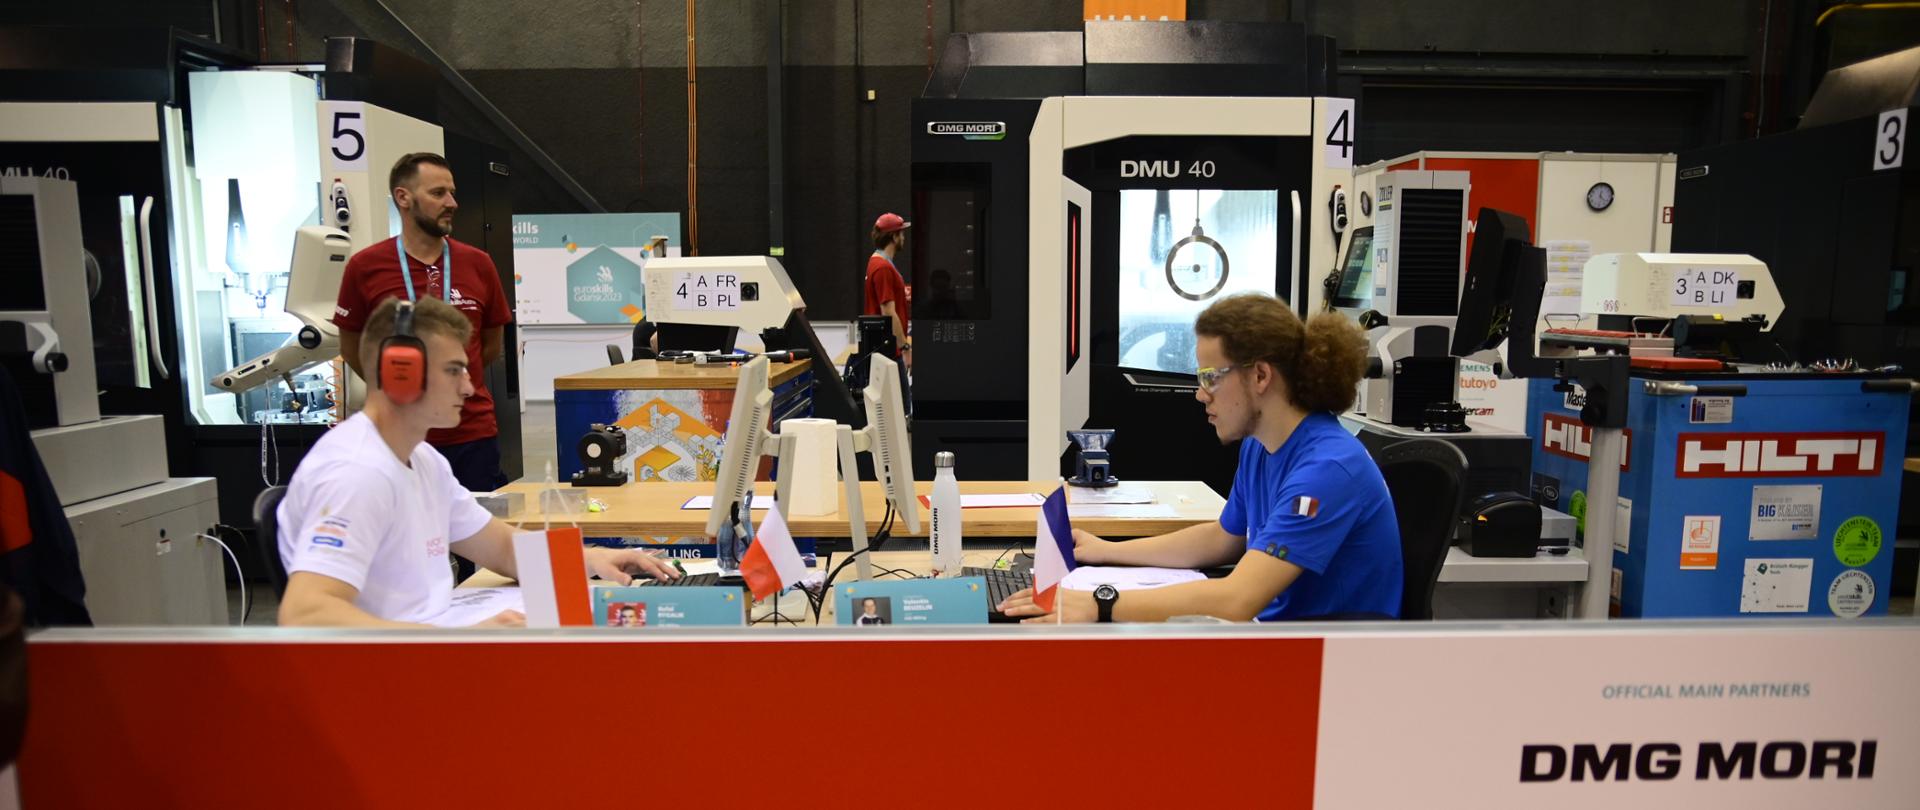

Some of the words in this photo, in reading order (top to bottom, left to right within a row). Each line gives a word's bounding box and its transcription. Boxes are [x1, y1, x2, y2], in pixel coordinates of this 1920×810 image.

[331, 112, 365, 161] 5
[937, 124, 964, 132] DMG
[965, 124, 997, 132] MORI
[1326, 109, 1353, 158] 4
[1880, 116, 1901, 165] 3
[1120, 160, 1180, 178] DMU
[1188, 160, 1216, 178] 40
[697, 275, 708, 287] A
[716, 275, 736, 287] FR
[1676, 278, 1687, 295] 3
[1696, 272, 1706, 284] A
[1713, 272, 1735, 285] DK
[676, 282, 688, 299] 4
[1695, 291, 1704, 303] B
[1711, 291, 1724, 303] LI
[697, 294, 708, 307] B
[717, 294, 736, 307] PL
[1544, 419, 1628, 466] HILI
[1683, 439, 1877, 472] HILTI
[1758, 504, 1776, 518] BIG
[1602, 684, 1673, 700] OFFICIAL
[1678, 683, 1724, 699] MAIN
[1729, 682, 1811, 698] PARTNERS
[1519, 742, 1682, 783] DMG
[1695, 740, 1878, 781] MORI
